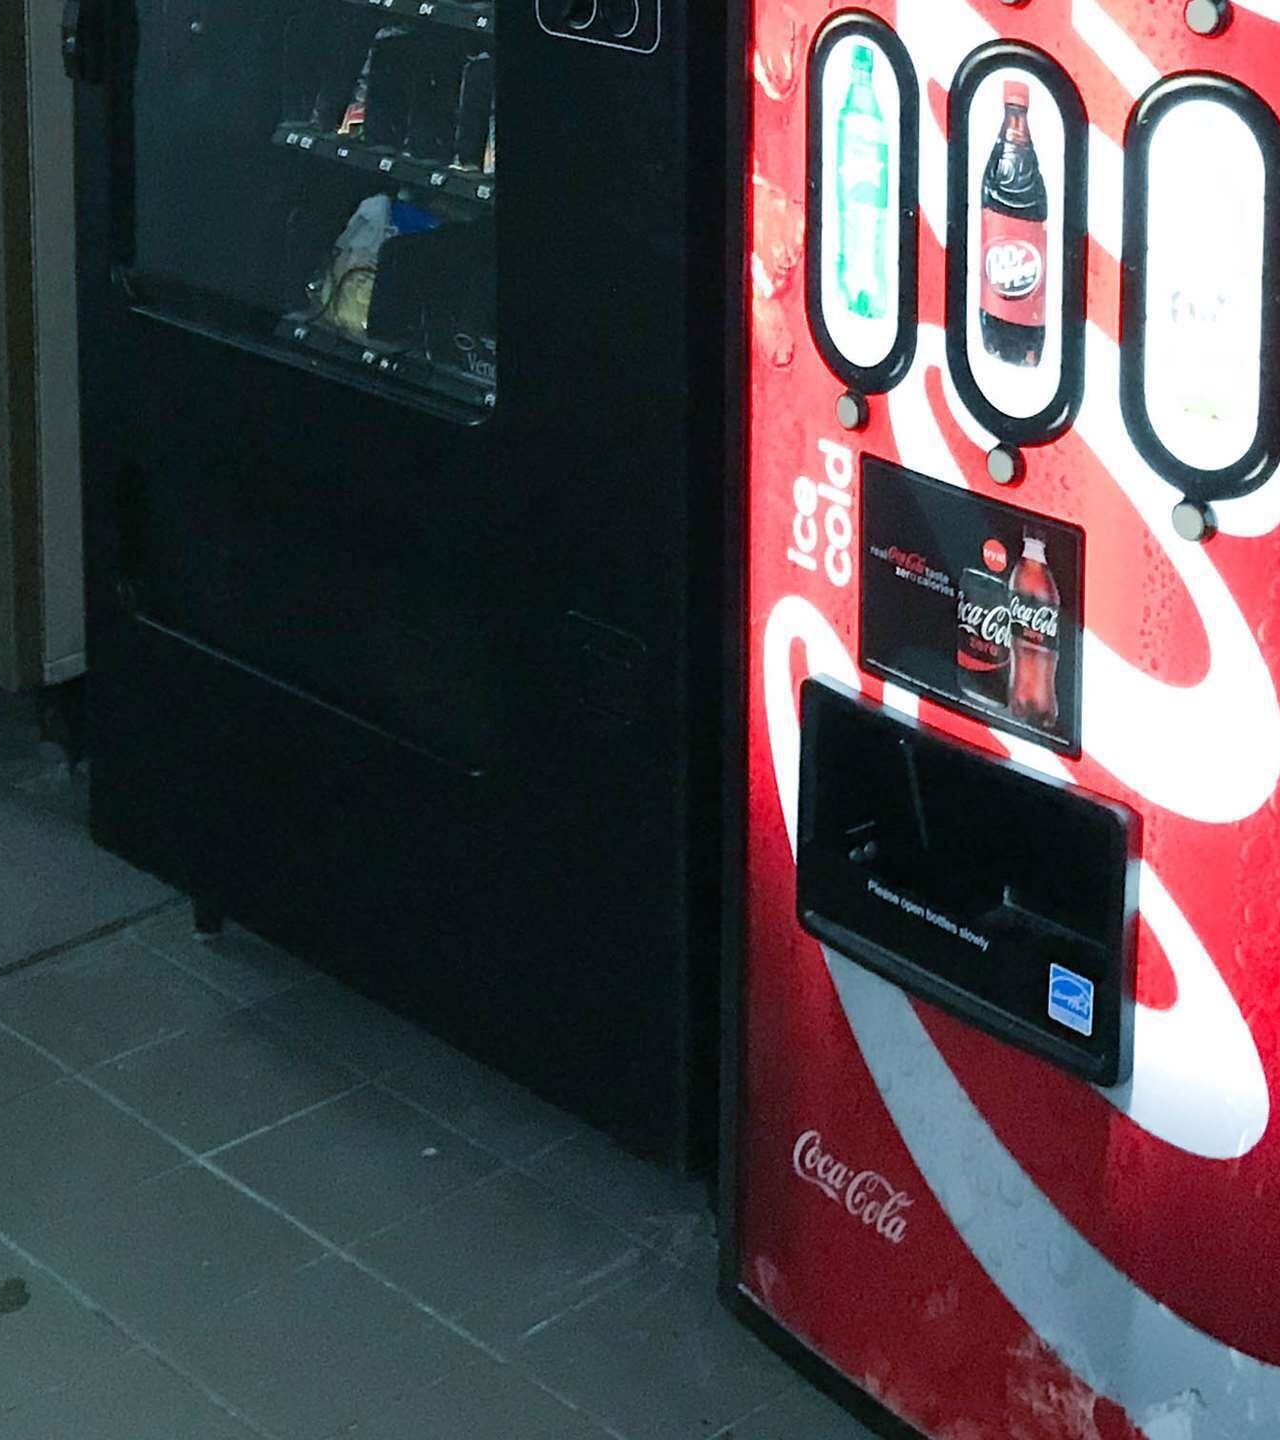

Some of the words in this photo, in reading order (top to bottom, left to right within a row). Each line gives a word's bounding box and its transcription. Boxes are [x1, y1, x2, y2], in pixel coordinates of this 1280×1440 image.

[787, 475, 818, 571] Ice
[817, 438, 853, 587] cold
[868, 879, 900, 905] Please
[900, 898, 925, 918] open
[926, 908, 958, 935] bottles
[959, 927, 990, 953] slowly
[792, 1129, 915, 1244] Coca-Cola
